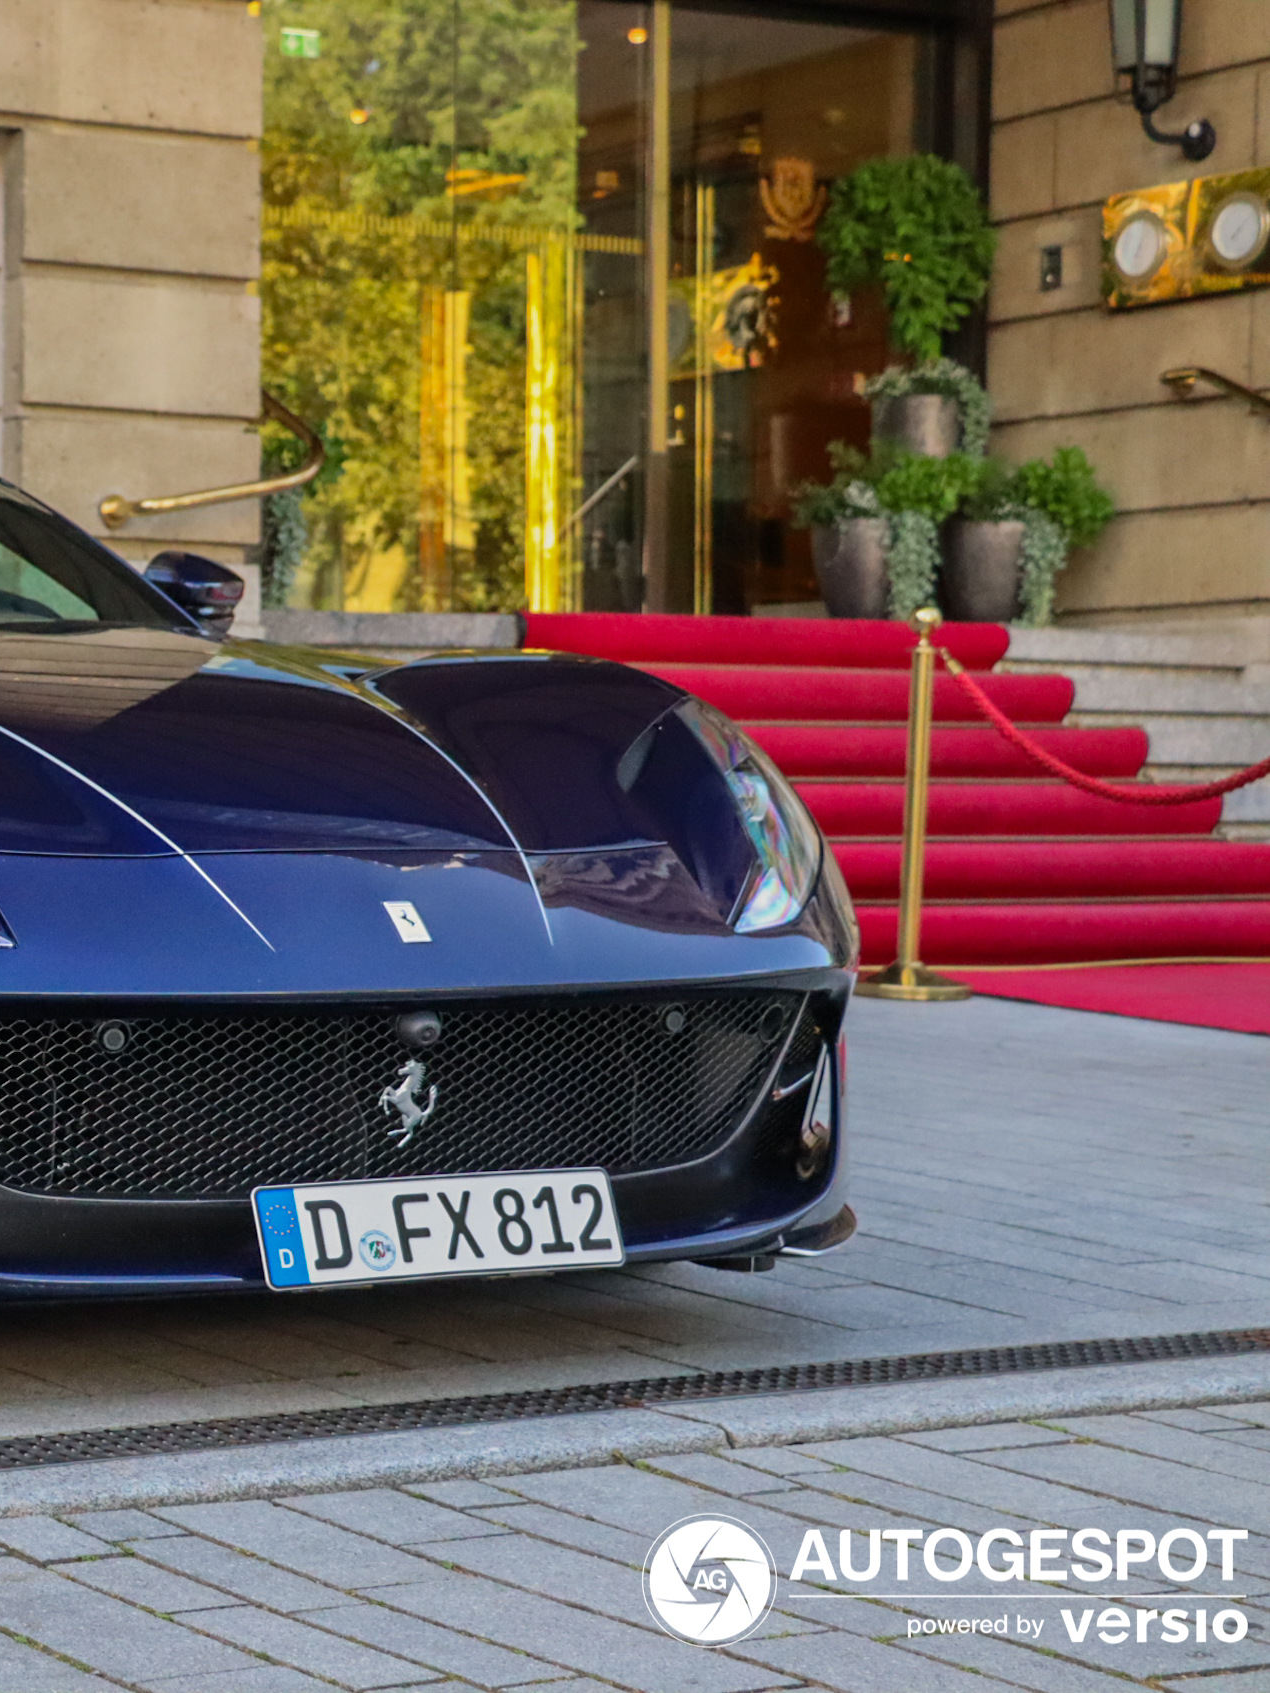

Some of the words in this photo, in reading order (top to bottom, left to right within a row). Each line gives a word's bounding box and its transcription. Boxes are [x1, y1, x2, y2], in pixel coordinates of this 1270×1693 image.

[304, 1200, 353, 1270] D
[392, 1191, 485, 1263] FX
[492, 1184, 612, 1256] 812
[278, 1249, 294, 1268] D
